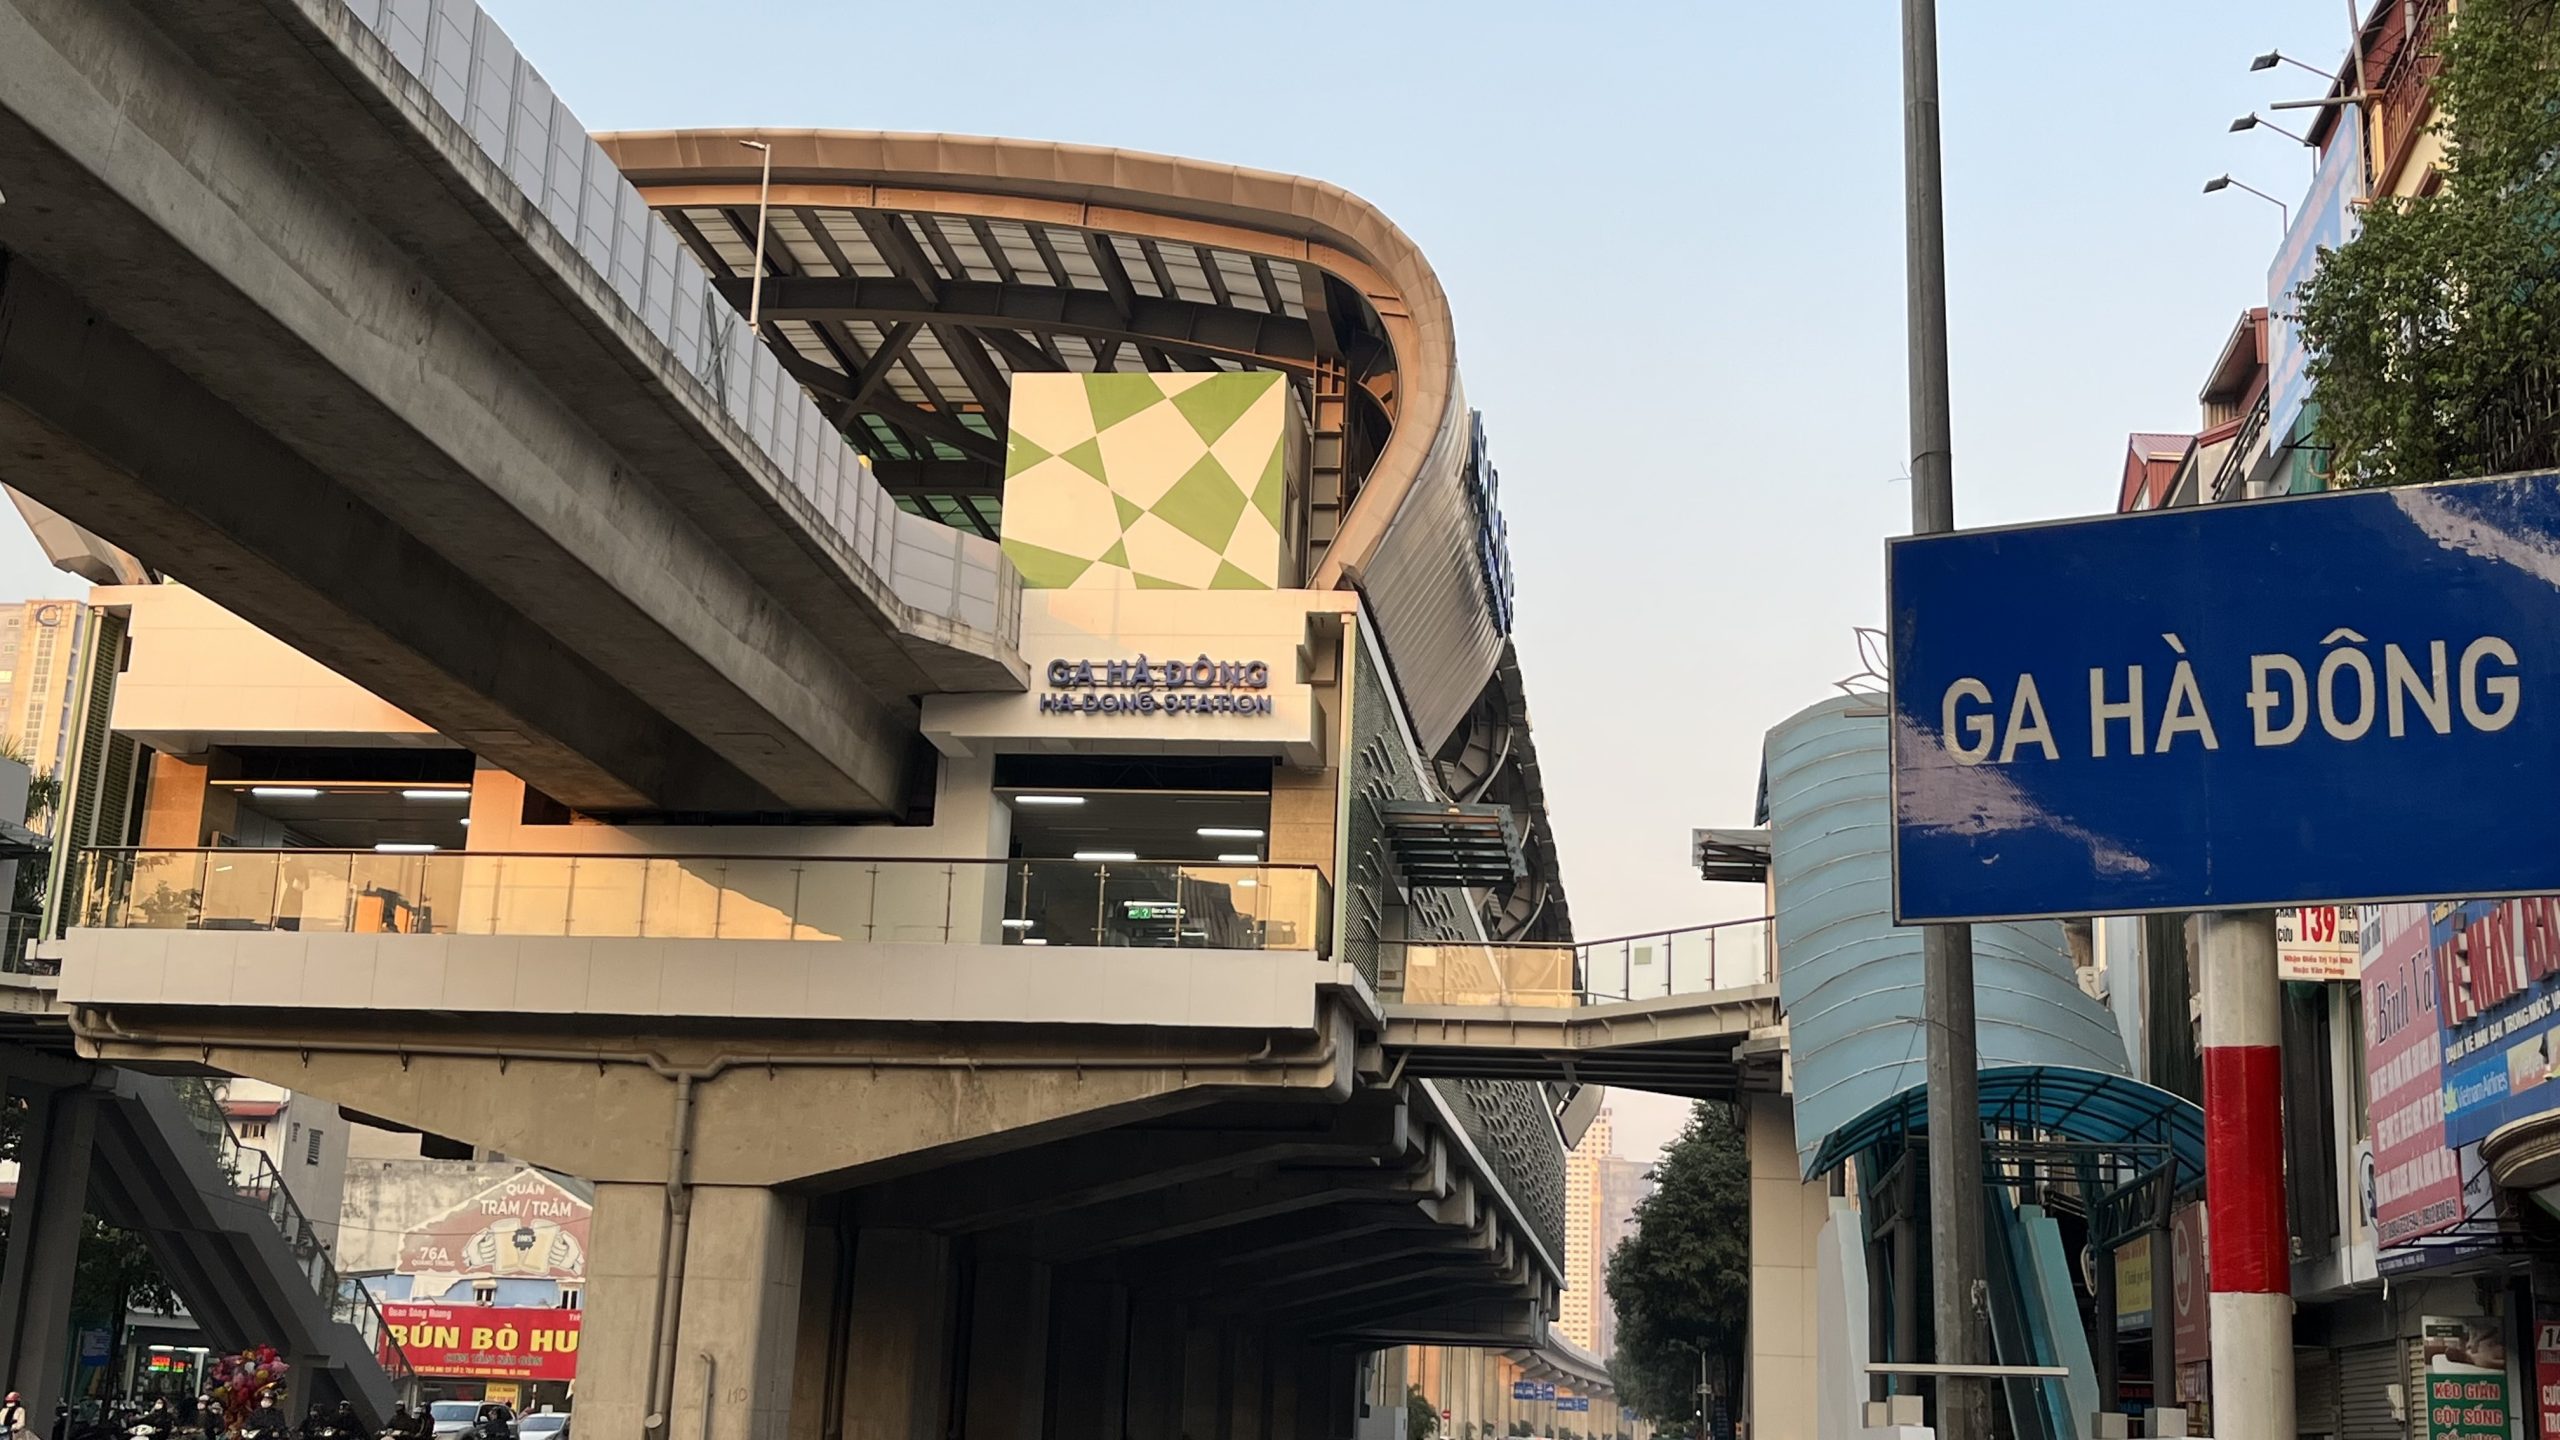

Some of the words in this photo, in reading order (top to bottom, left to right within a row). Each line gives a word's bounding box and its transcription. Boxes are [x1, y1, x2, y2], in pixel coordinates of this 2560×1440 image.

[1047, 657, 1096, 687] GA
[1106, 653, 1154, 687] HÀ
[1164, 653, 1269, 688] ĐÔNG
[1040, 693, 1075, 714] HA
[1082, 693, 1155, 716] DONG
[1163, 694, 1272, 716] STATION
[1942, 673, 2060, 766] GA
[2089, 632, 2219, 758] HÀ
[2246, 627, 2521, 747] ĐÔNG
[2299, 906, 2335, 943] 139
[2377, 965, 2409, 1044] Bình
[506, 1183, 545, 1195] QUÁN
[480, 1196, 520, 1216] TRĂM
[532, 1198, 572, 1217] TRĂM
[420, 1247, 448, 1261] 76A
[386, 1320, 460, 1349] BÚN
[471, 1323, 519, 1351] BÒ
[2433, 1379, 2462, 1399] KÉO
[2465, 1380, 2500, 1400] GIÃN
[2433, 1405, 2460, 1428] CỘT
[2463, 1403, 2503, 1426] SỐNG
